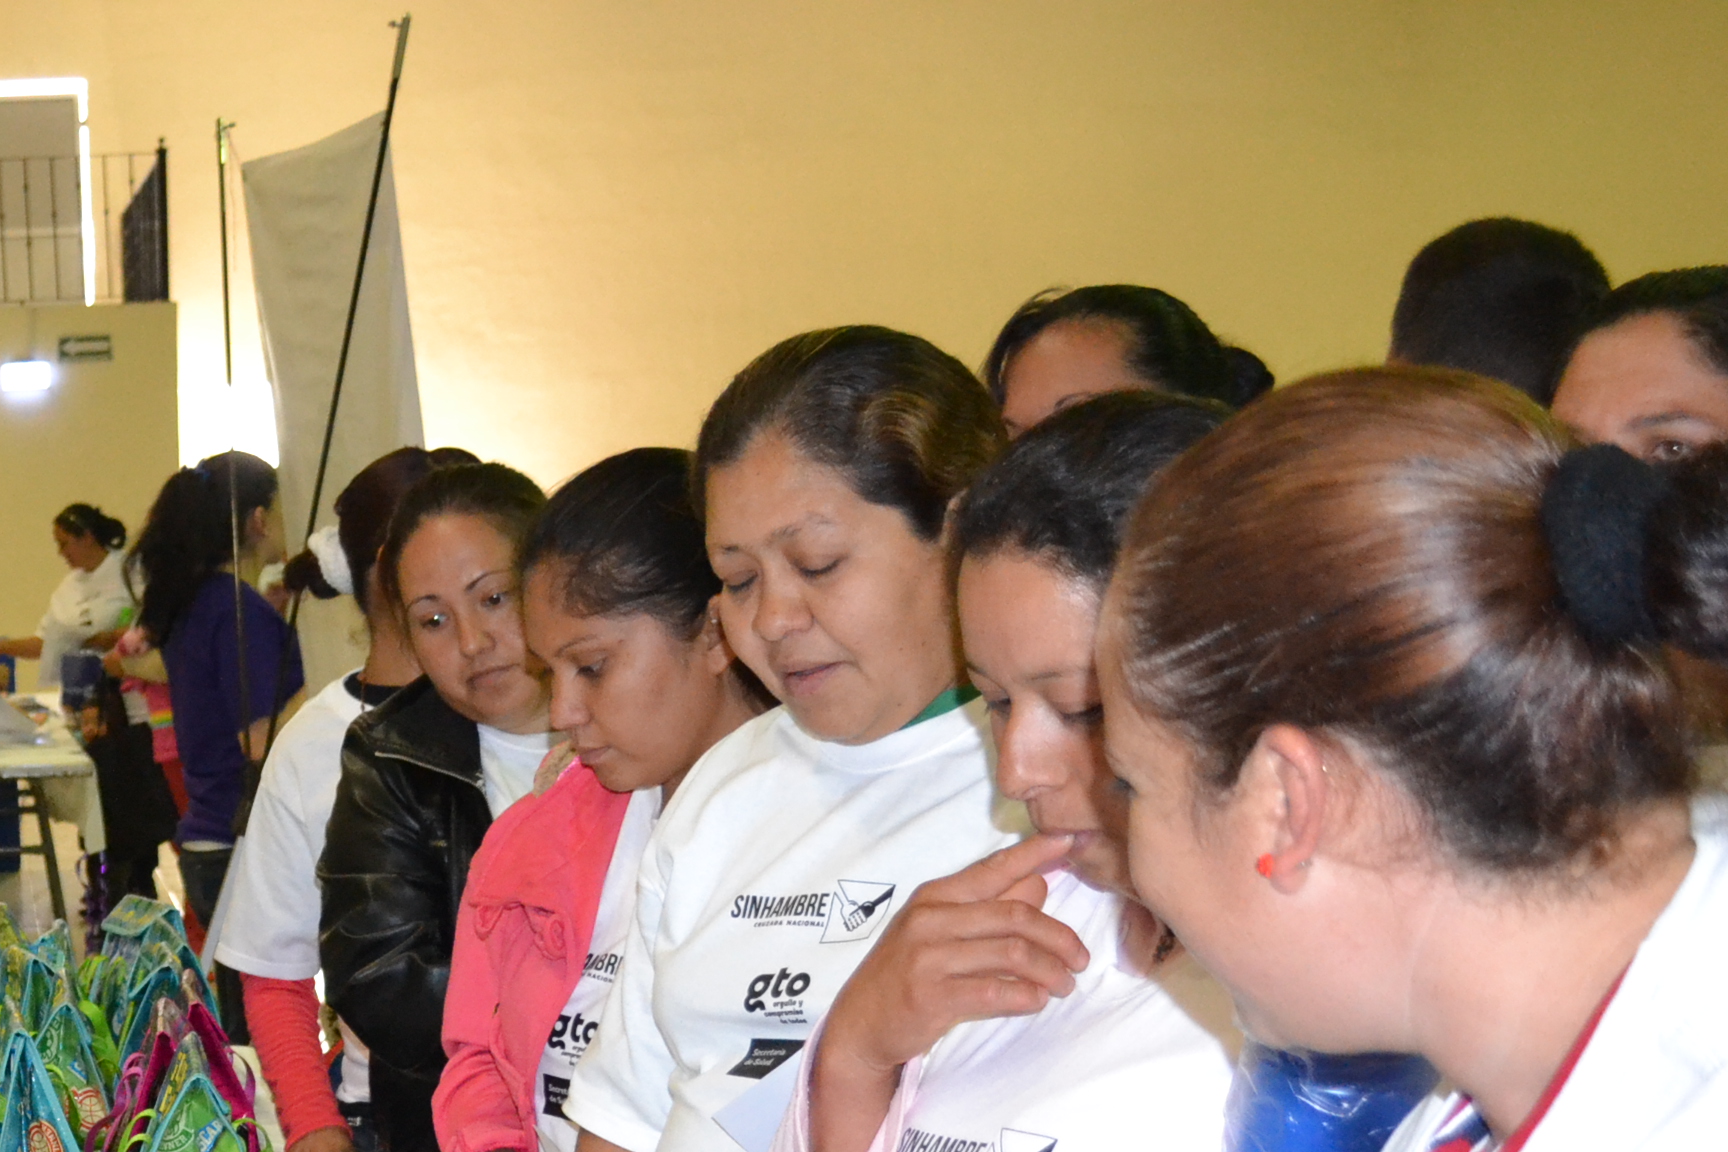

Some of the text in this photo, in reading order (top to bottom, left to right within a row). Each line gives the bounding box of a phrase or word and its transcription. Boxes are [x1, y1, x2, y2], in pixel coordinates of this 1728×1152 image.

[731, 893, 830, 919] SINHAMBRE
[744, 967, 811, 1013] gto
[753, 1058, 775, 1066] Salud
